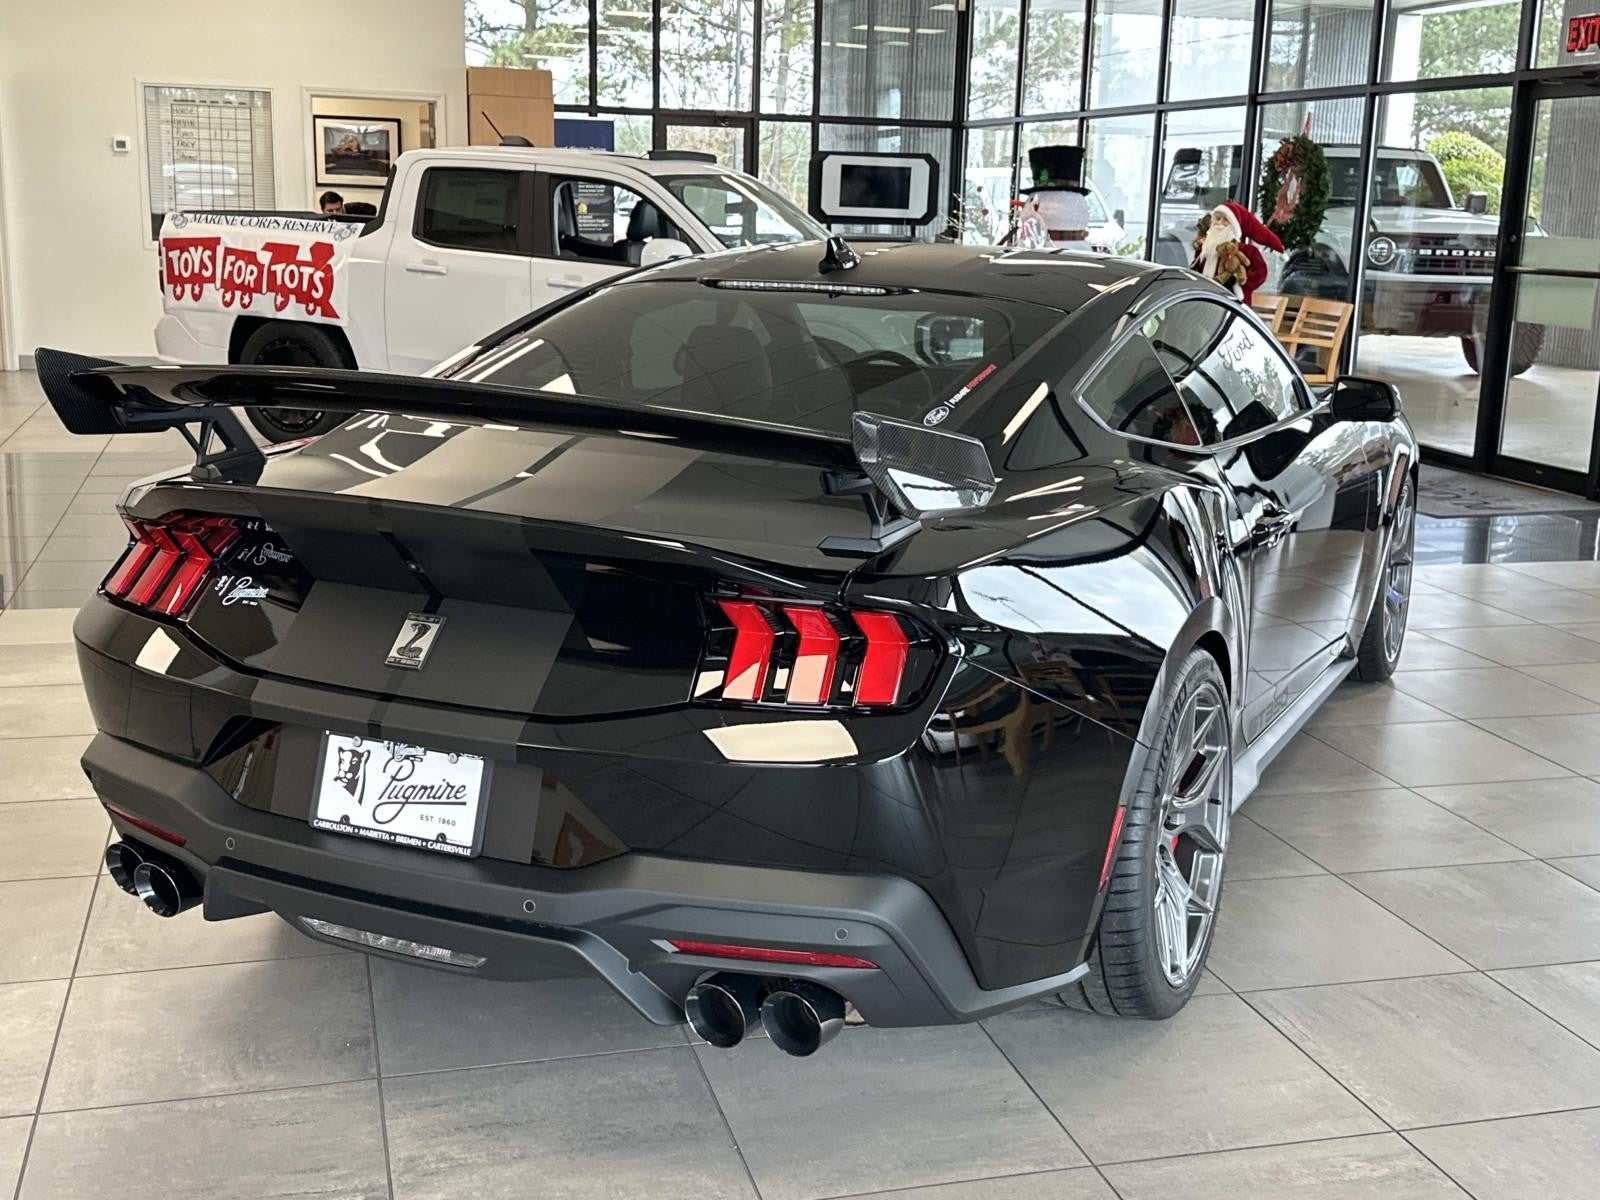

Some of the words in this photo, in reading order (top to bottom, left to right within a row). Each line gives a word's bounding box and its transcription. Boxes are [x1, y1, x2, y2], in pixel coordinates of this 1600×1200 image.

[190, 213, 238, 226] MARINE
[241, 217, 281, 229] CORPS
[282, 221, 336, 234] RESERVE
[1418, 249, 1497, 257] BRONC
[168, 246, 213, 278] TOYS
[223, 255, 258, 288] FOR
[270, 262, 325, 299] TOTS
[1217, 329, 1255, 371] Ford
[372, 757, 468, 824] Pugmire
[313, 820, 354, 833] CARROLLTON
[359, 828, 390, 841] MARIETTA
[396, 835, 422, 846] BREMEN
[428, 841, 471, 856] CARTERSVILLE
[438, 817, 457, 827] 1960
